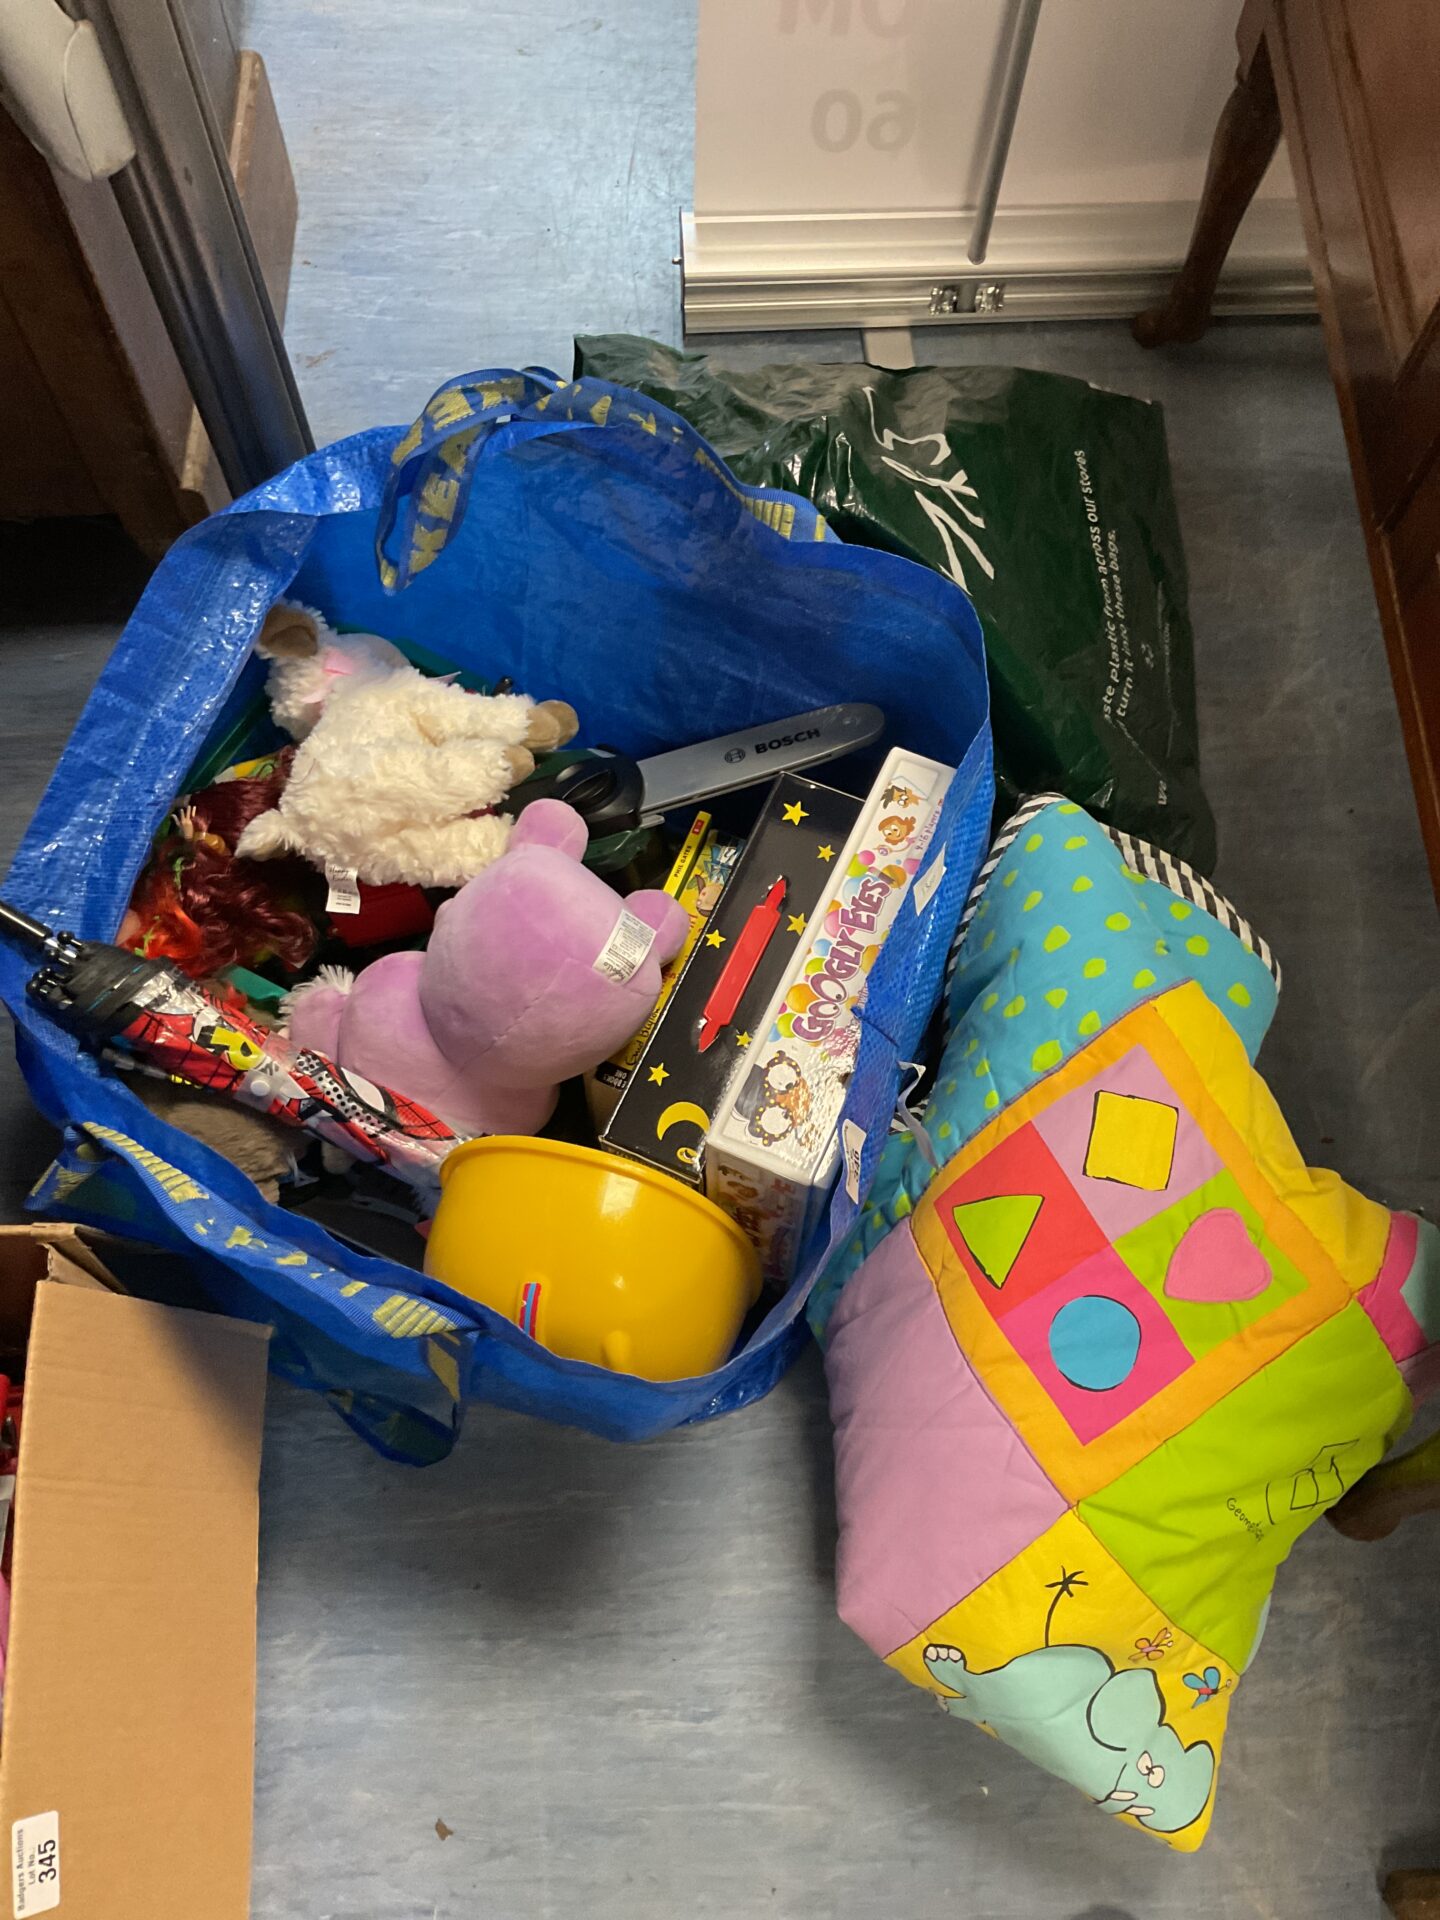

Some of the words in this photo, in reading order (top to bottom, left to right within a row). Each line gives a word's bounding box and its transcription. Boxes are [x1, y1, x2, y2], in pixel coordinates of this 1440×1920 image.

[1074, 450, 1092, 494] stores
[1084, 496, 1098, 523] our
[1090, 526, 1107, 575] across
[1108, 530, 1119, 571] bags.
[1100, 578, 1114, 619] from
[1112, 575, 1126, 619] these
[1105, 621, 1120, 684] plastic
[1119, 624, 1132, 656] into
[1124, 660, 1134, 672] it
[1116, 677, 1133, 717] turn
[755, 728, 820, 754] BOSCH
[674, 865, 683, 877] PHIL
[681, 845, 692, 863] GATES
[793, 930, 864, 1041] GOOGLY
[16, 1829, 24, 1869] Auctions
[38, 1840, 56, 1883] 345
[17, 1873, 26, 1911] Badgers
